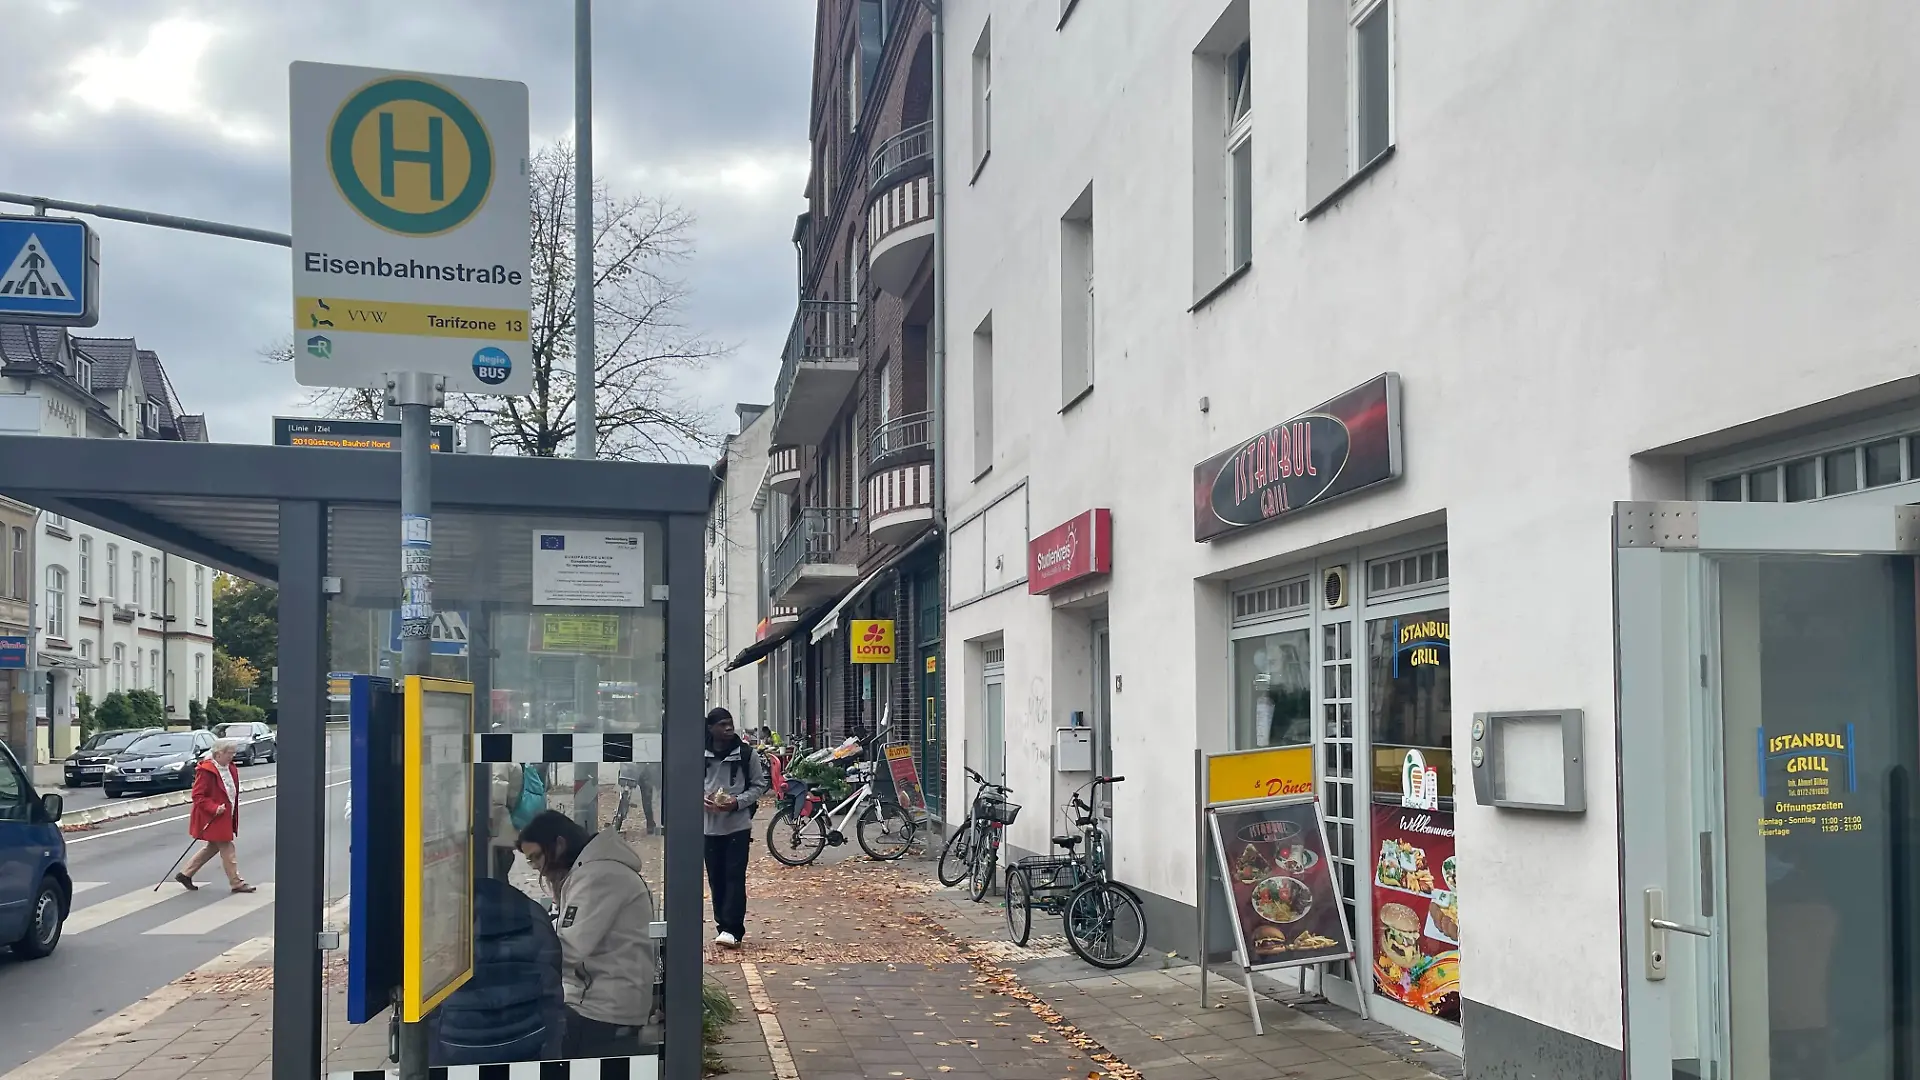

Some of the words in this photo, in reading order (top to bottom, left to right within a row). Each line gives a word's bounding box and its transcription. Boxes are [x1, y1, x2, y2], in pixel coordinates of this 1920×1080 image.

[379, 112, 444, 202] H
[304, 252, 522, 285] Eisenbahnstraße
[348, 310, 387, 324] VVW
[427, 315, 496, 331] Tarifzone
[505, 320, 523, 332] 13
[479, 354, 506, 366] Regio
[479, 366, 506, 379] BUS
[342, 440, 370, 448] Bauhof
[371, 440, 391, 449] Nord
[1234, 421, 1317, 507] ISTANBUL
[1260, 482, 1290, 520] GRILL
[1037, 543, 1071, 571] Studienkreis
[1400, 621, 1450, 644] ISTANBUL
[856, 644, 891, 655] LOTTO
[1410, 648, 1440, 667] GRILL
[1769, 732, 1845, 753] ISTANBUL
[1786, 756, 1829, 773] GRILL
[1254, 779, 1261, 789] &
[1265, 778, 1313, 797] Döner
[1775, 801, 1844, 813] Öffnungszeiten
[1758, 818, 1783, 826] Montag
[1788, 816, 1816, 825] Sonntag
[1821, 817, 1838, 825] 11:00
[1843, 815, 1862, 824] 21:00
[1758, 828, 1791, 836] Feiertage
[1821, 824, 1838, 832] 11:00
[1844, 823, 1862, 832] 21:00
